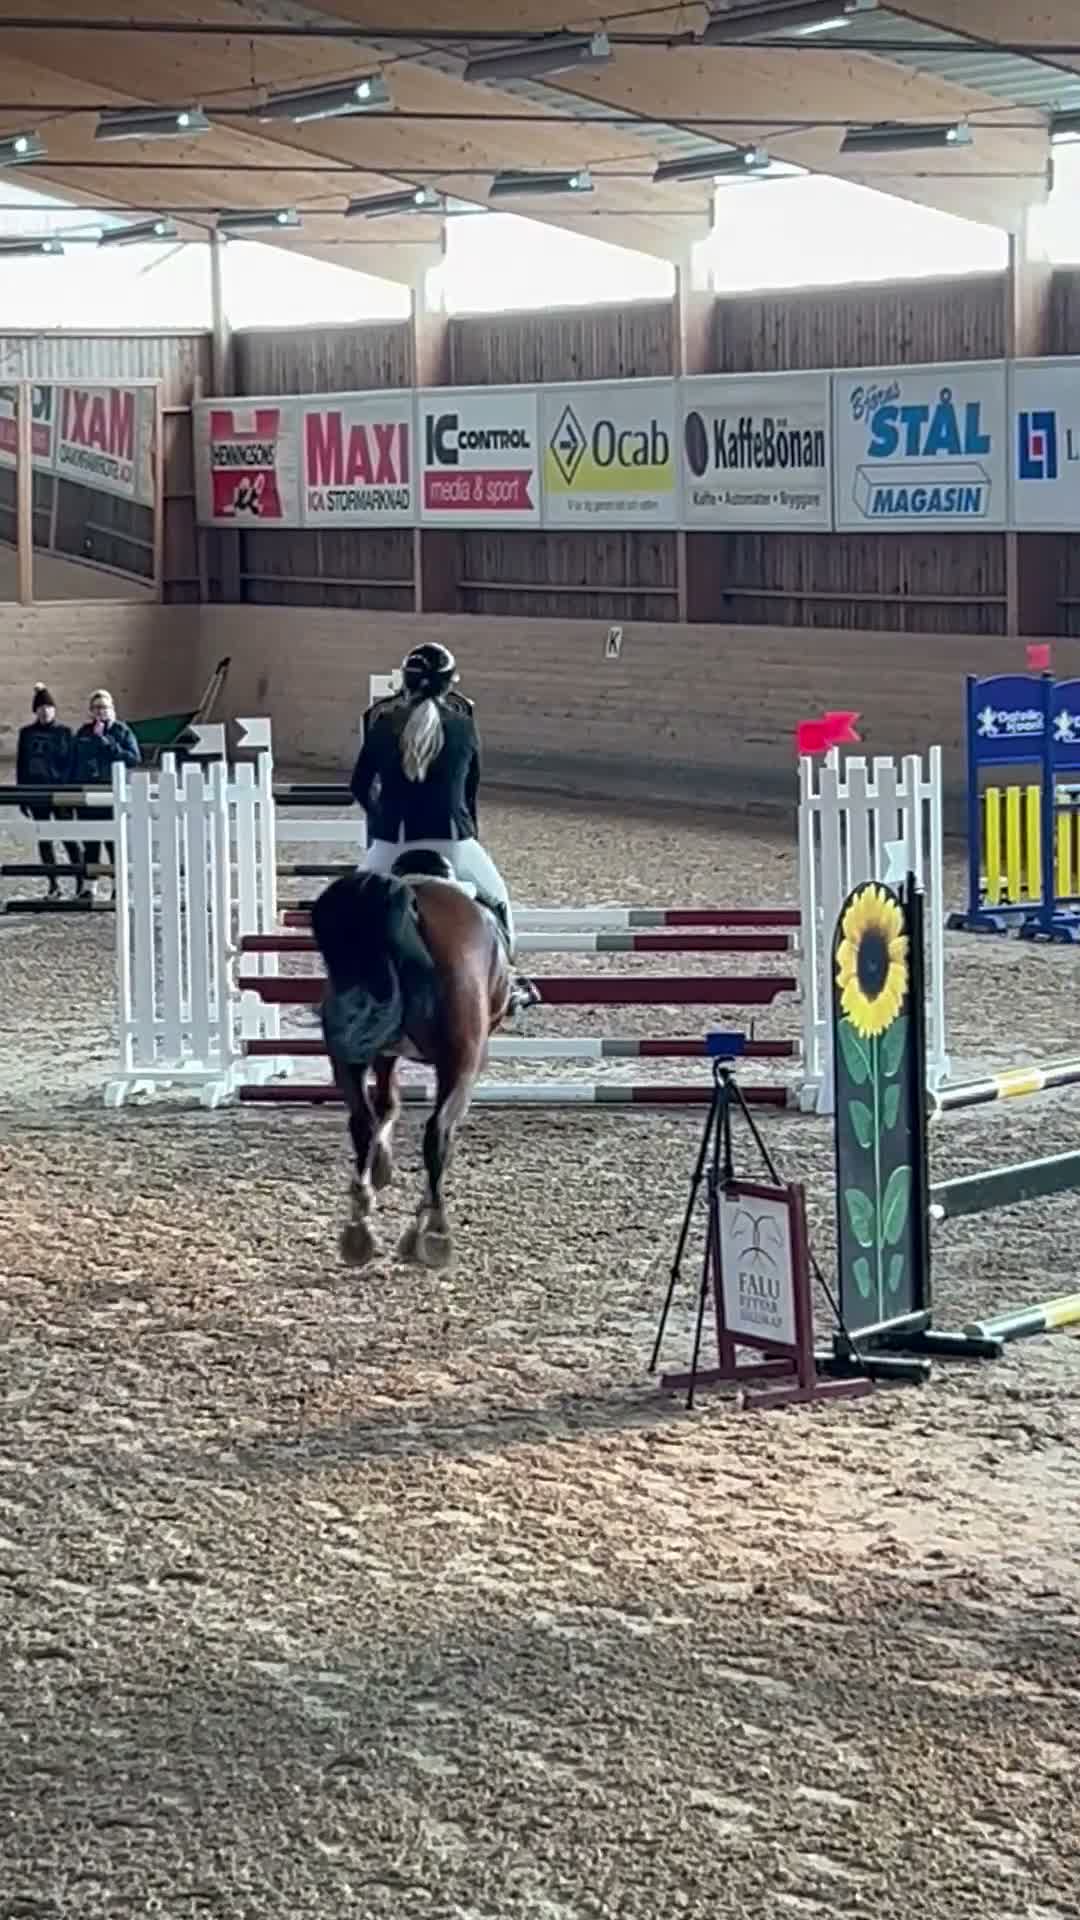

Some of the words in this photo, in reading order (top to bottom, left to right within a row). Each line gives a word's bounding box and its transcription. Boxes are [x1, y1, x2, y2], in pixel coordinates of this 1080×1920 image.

[425, 414, 458, 465] IC
[458, 430, 530, 450] CONTROL
[867, 387, 991, 457] STÅL
[305, 412, 409, 486] MAXI
[592, 420, 669, 467] Ocab
[714, 417, 824, 469] KaffeBönan
[327, 490, 410, 512] STORMARKNAD
[430, 479, 469, 500] media
[473, 477, 484, 500] &
[487, 477, 519, 503] sport
[873, 487, 982, 513] MAGASIN
[608, 631, 620, 653] K
[739, 1272, 780, 1300] FALU
